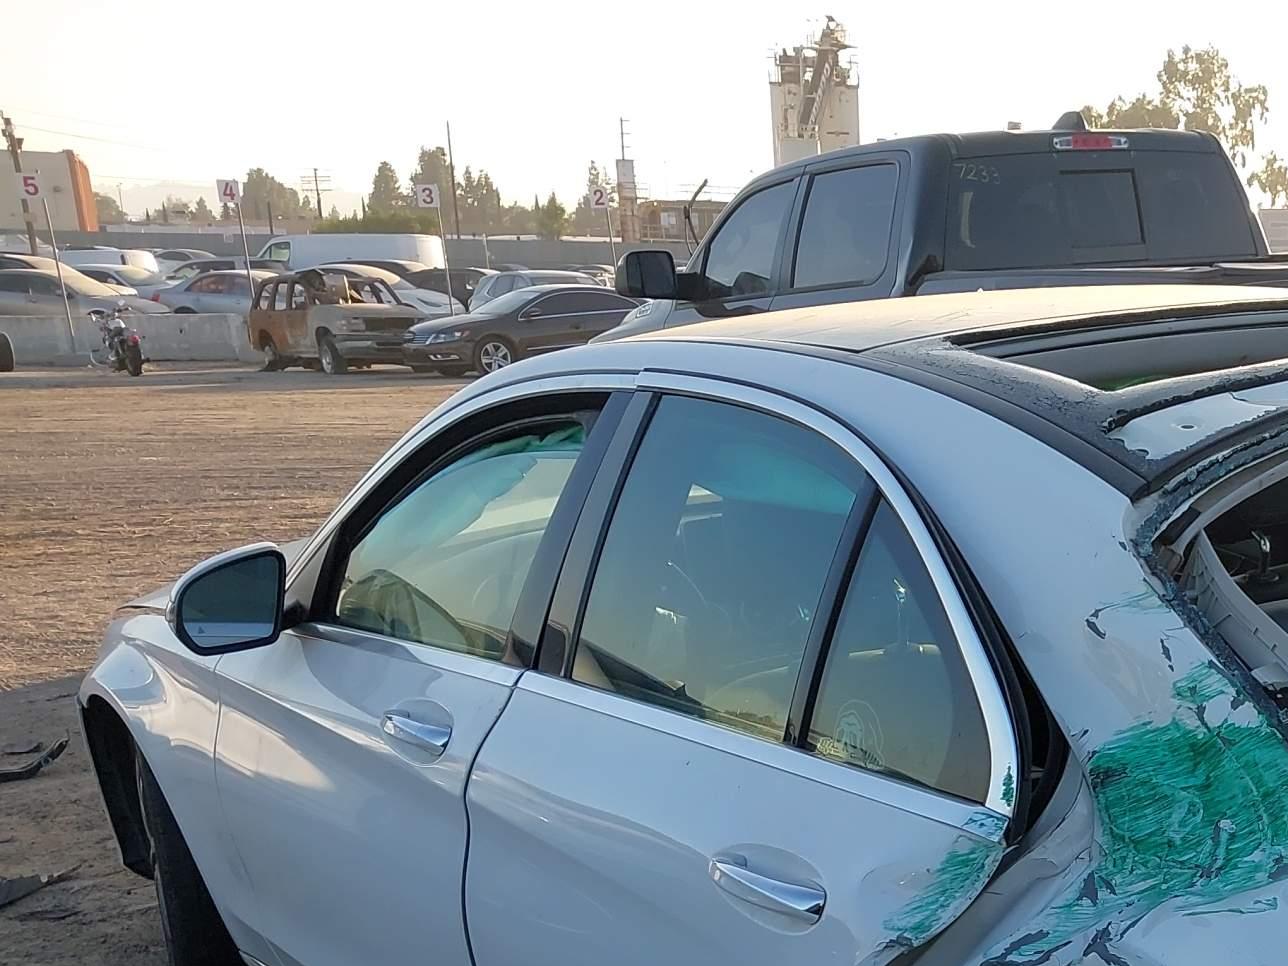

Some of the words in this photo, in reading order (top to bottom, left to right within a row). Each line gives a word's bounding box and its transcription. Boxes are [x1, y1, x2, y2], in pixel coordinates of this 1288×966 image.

[22, 176, 39, 196] 5
[222, 181, 237, 201] 4
[421, 187, 434, 205] 3
[592, 188, 606, 206] 2
